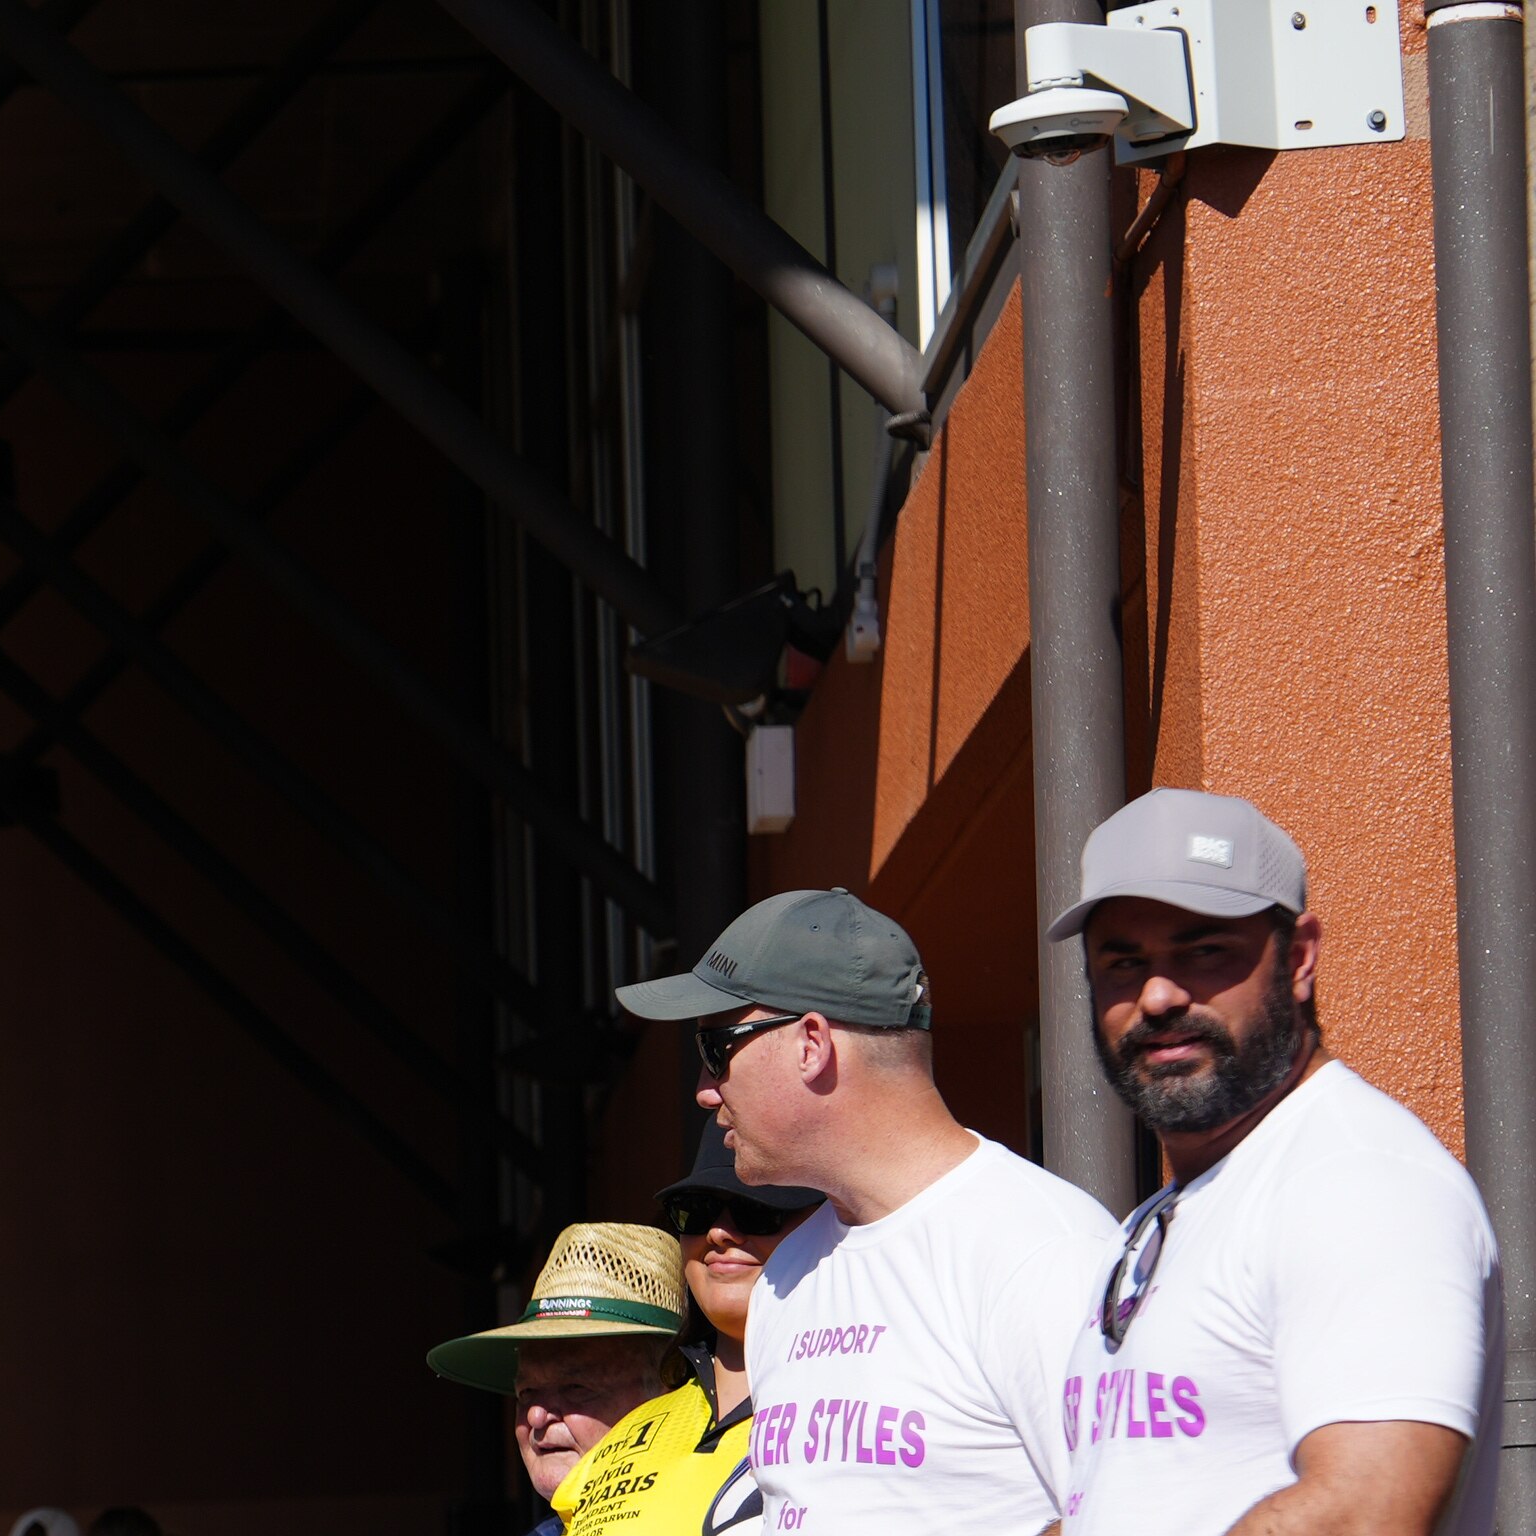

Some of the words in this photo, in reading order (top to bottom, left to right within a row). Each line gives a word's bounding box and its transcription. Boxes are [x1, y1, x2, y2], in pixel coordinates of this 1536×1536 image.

[706, 950, 738, 979] MINI
[539, 1298, 592, 1310] BUNNINGS
[787, 1333, 798, 1363] I
[796, 1323, 888, 1361] SUPPORT
[592, 1435, 632, 1464] VOTE
[628, 1420, 655, 1449] 1
[748, 1402, 797, 1471] TER
[804, 1398, 926, 1469] STYLES
[580, 1460, 634, 1497] Sylvia
[593, 1509, 641, 1527] DARWIN
[777, 1500, 808, 1531] for
